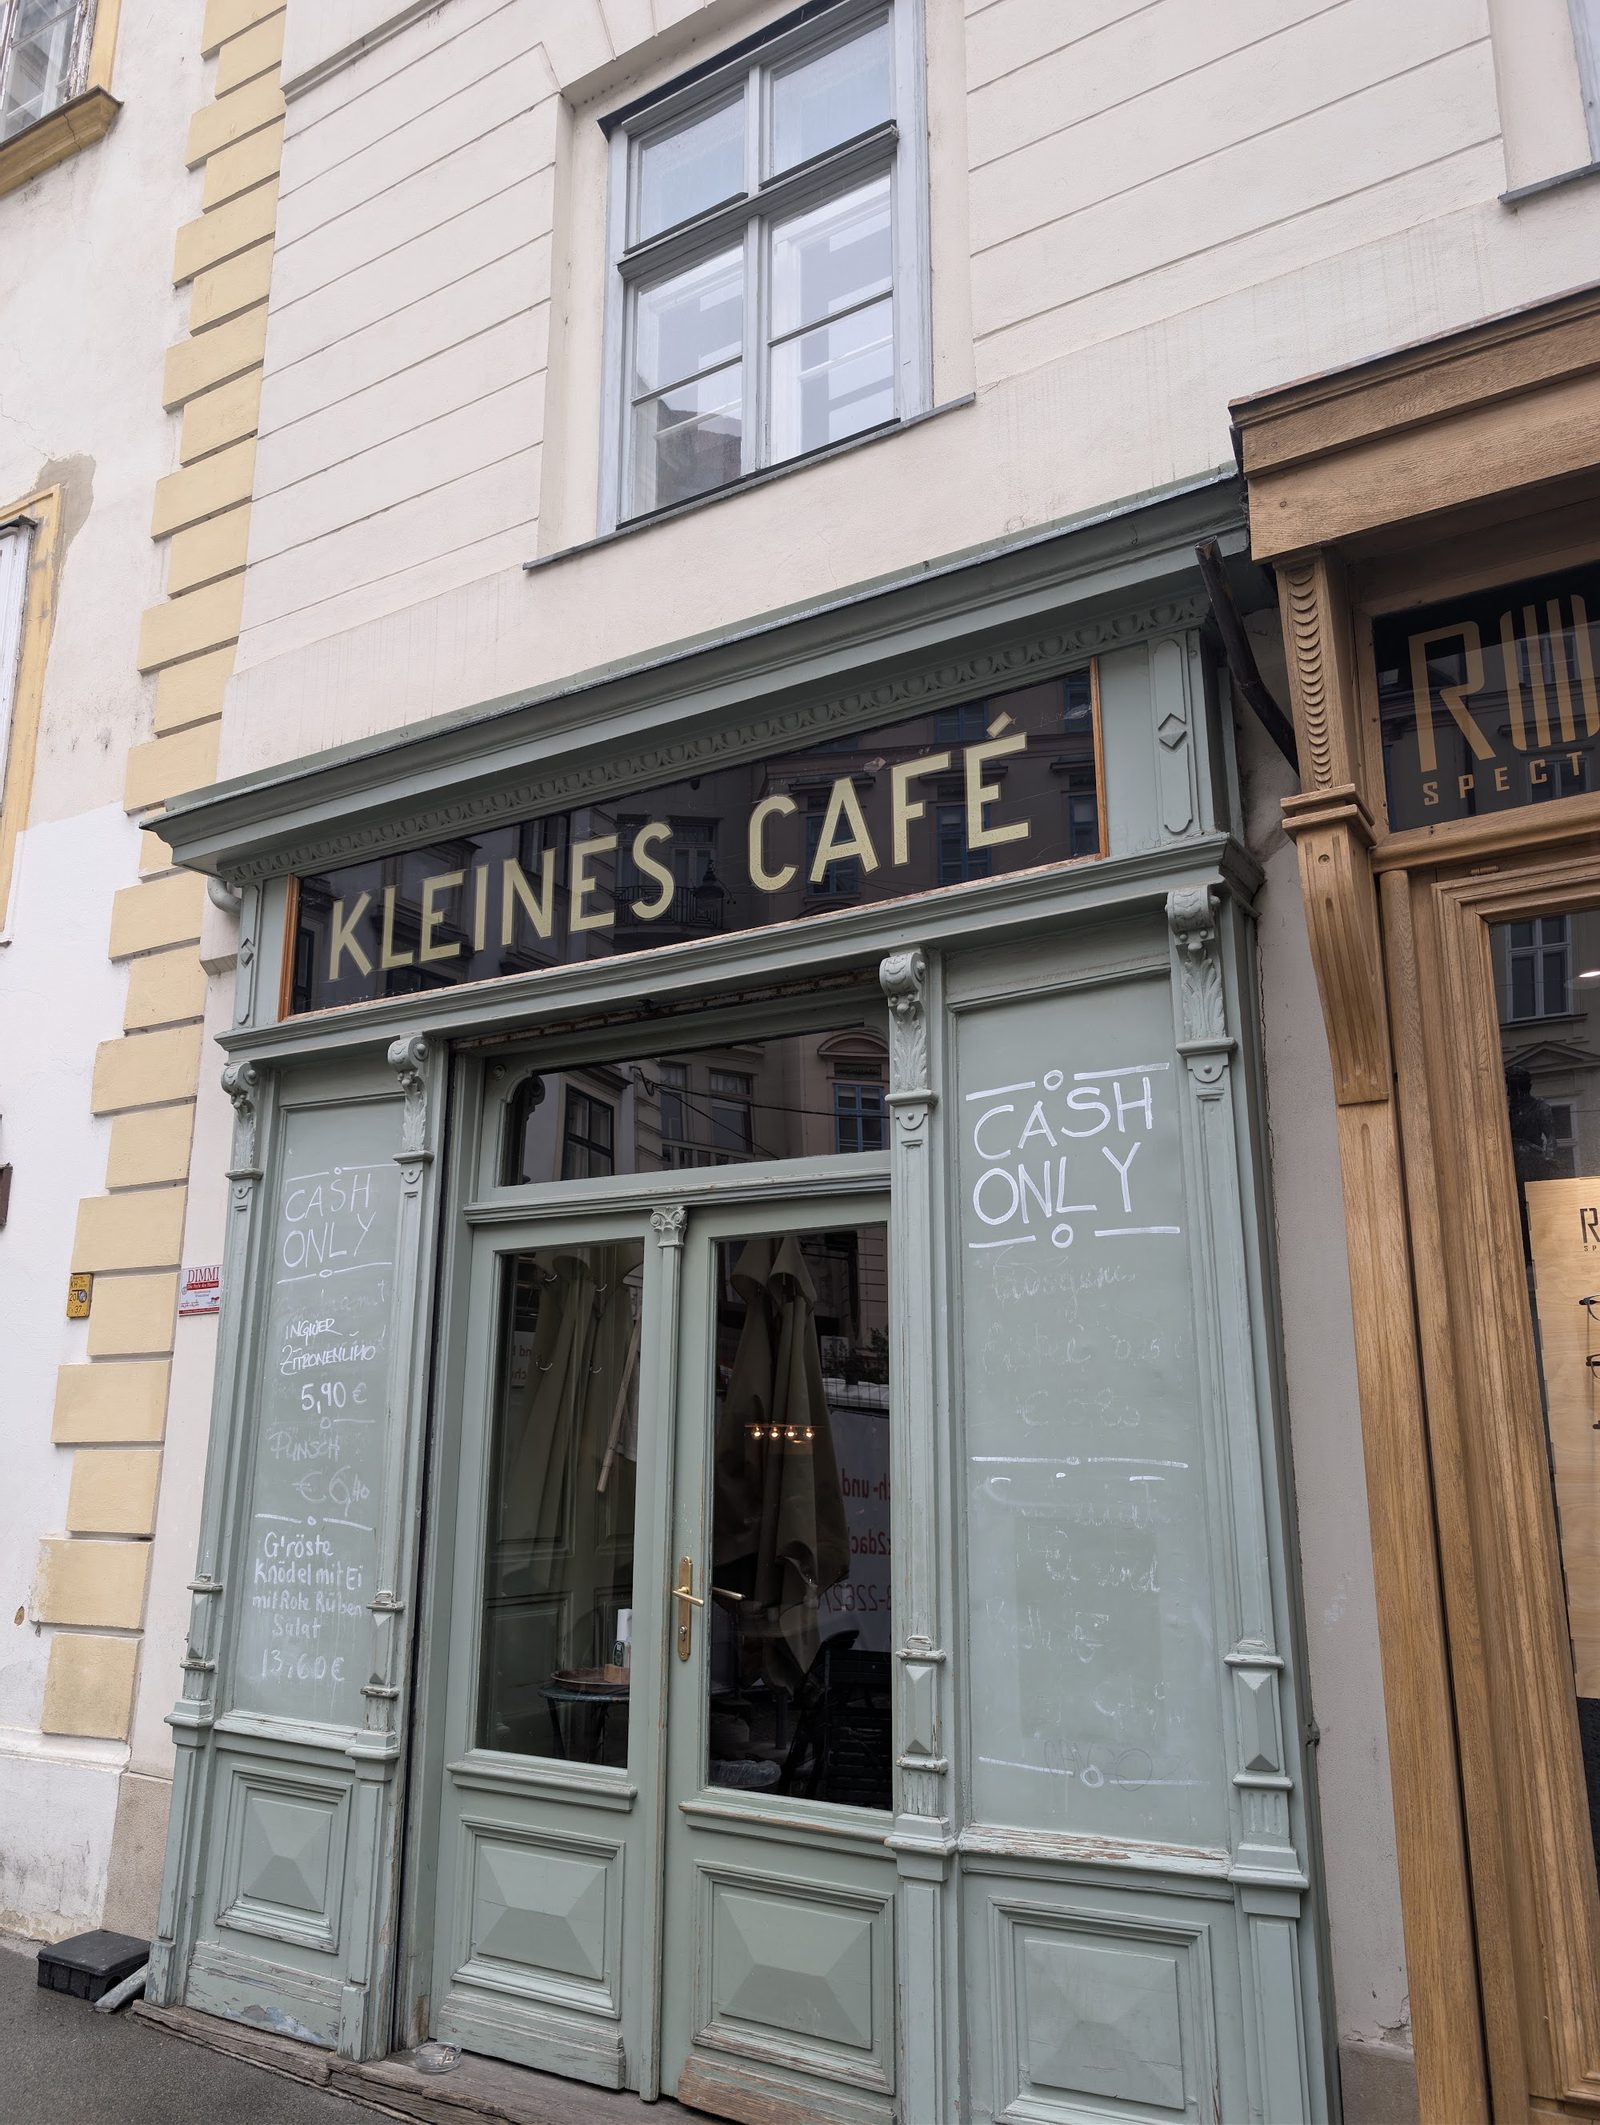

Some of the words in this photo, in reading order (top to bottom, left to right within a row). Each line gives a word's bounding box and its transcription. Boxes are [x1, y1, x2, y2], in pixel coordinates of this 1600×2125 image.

[327, 821, 676, 982] KLEINES
[748, 711, 1031, 893] CAFÉ
[974, 1077, 1153, 1161] CASH
[285, 1173, 371, 1222] CASH
[973, 1142, 1142, 1226] ONLY
[283, 1211, 376, 1268] ONLY
[188, 1266, 220, 1283] DIMMI
[254, 1558, 312, 1586] Knödel
[316, 1561, 344, 1585] mit
[346, 1565, 363, 1590] Ei
[252, 1590, 277, 1611] mit
[272, 1613, 322, 1639] Salat
